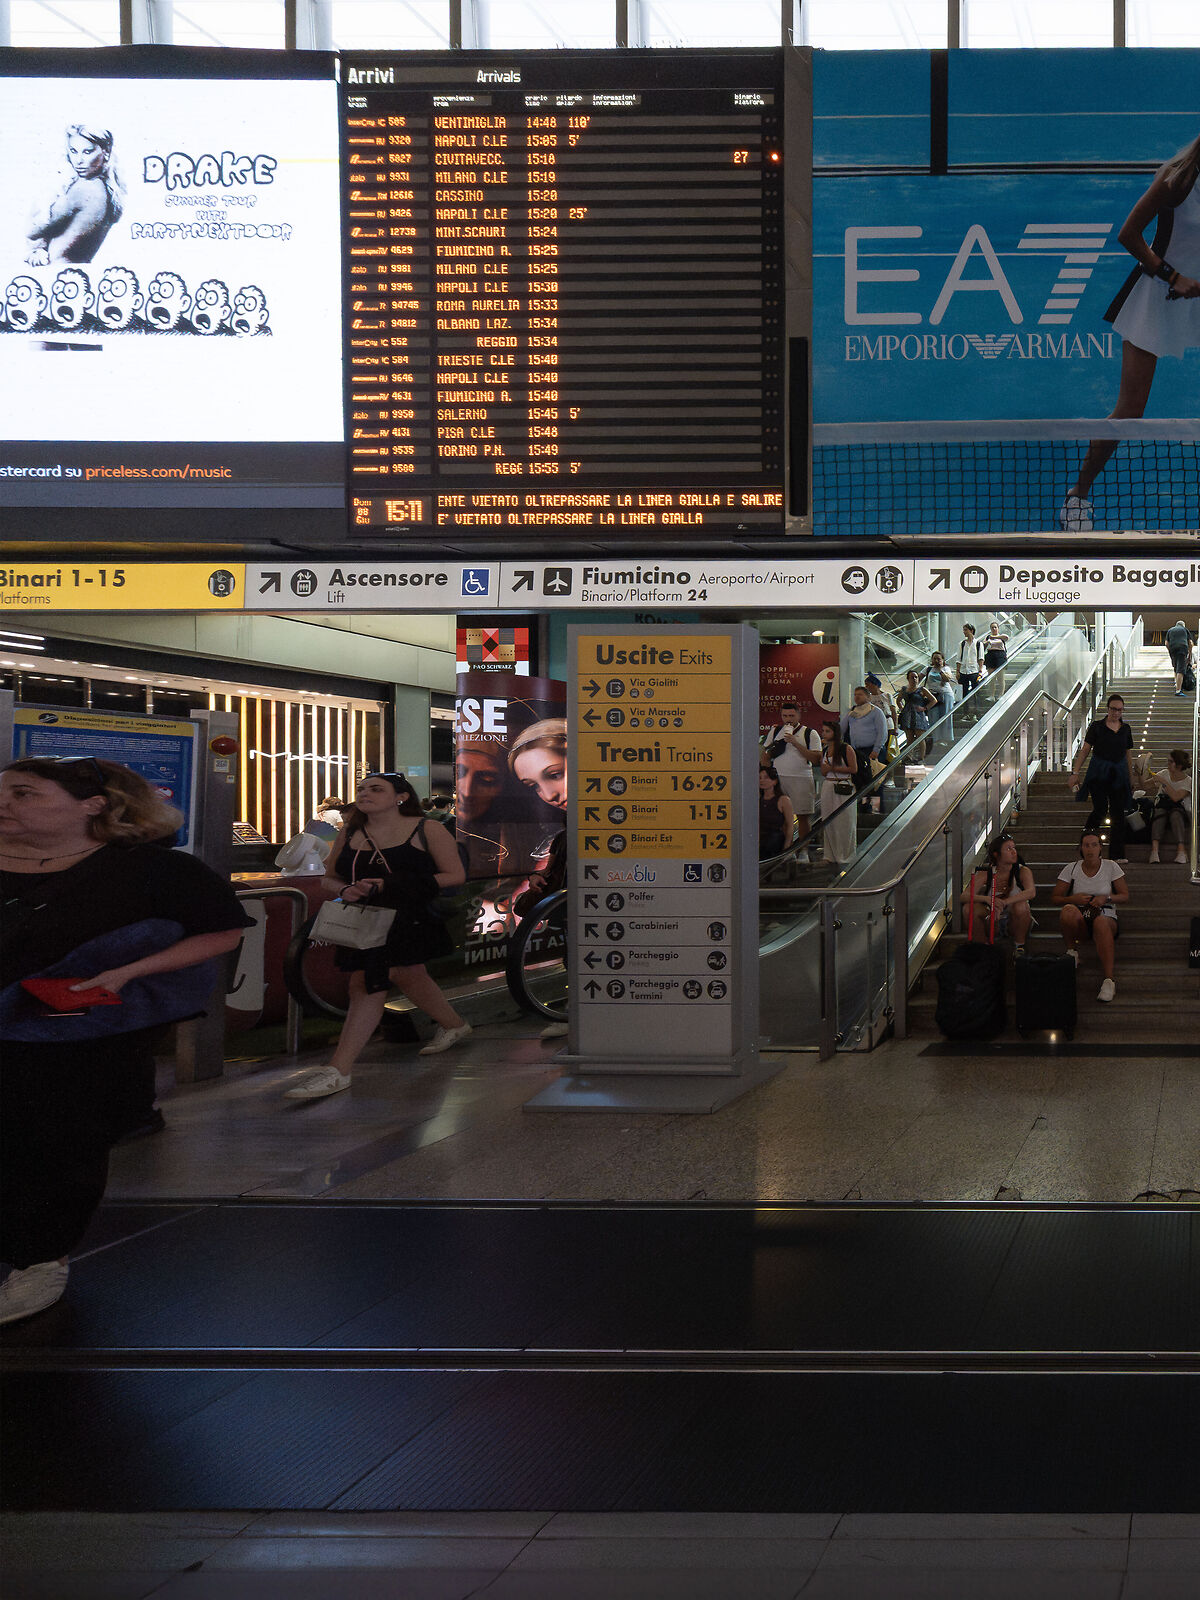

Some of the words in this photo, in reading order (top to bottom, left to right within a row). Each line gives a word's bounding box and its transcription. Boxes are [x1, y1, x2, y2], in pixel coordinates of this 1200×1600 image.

[348, 68, 394, 84] Arrivi
[477, 70, 521, 83] Arrivals
[435, 117, 506, 128] VENTIMIGLIA
[527, 117, 557, 128] 14:48
[435, 153, 505, 165] CIVITAVECC.
[734, 151, 748, 163] 27
[144, 151, 277, 190] DRAKE
[165, 195, 218, 207] SUMMER
[222, 195, 257, 208] TOUR
[131, 222, 292, 240] PARTYNEXTDOOR
[436, 227, 505, 237] MINT.SCAURI
[528, 226, 557, 237] 15:24
[844, 224, 1112, 325] EA7
[437, 300, 465, 311] ROMA
[472, 300, 520, 310] AURELIA
[528, 299, 558, 310] 15:33
[477, 337, 517, 347] REGGIO
[844, 334, 966, 361] EMPORIO
[1008, 333, 1113, 359] ARMANI
[437, 409, 487, 420] SALERNO
[528, 408, 558, 419] 15:45
[65, 469, 81, 477] su
[86, 464, 232, 480] priceless.com/music
[438, 495, 465, 506] ENTE
[472, 495, 518, 506] VIETATO
[525, 495, 610, 506] OLTREPASSARE
[617, 495, 632, 506] LA
[639, 495, 672, 506] LINEA
[679, 494, 720, 506] GIALLA
[727, 494, 734, 505] E
[742, 494, 782, 505] SALIRE
[385, 500, 422, 521] 15:11
[0, 569, 61, 587] Binari
[72, 569, 125, 587] 1-15
[328, 569, 448, 588] Ascensore
[582, 567, 691, 585] Fiumicino
[699, 571, 814, 586] Aeroporto/Airport
[999, 565, 1102, 589] Deposito
[0, 592, 51, 604] latforms
[328, 591, 345, 603] Lift
[582, 589, 683, 603] Binario/Platform
[688, 589, 707, 601] 24
[999, 587, 1021, 601] Left
[1024, 588, 1081, 605] Luggage
[597, 644, 674, 664] Uscite
[680, 650, 712, 664] Exits
[630, 708, 645, 716] Via
[649, 708, 685, 716] Marsala
[597, 742, 660, 762] Treni
[667, 747, 712, 762] Trains
[631, 776, 657, 784] Binari
[629, 893, 654, 901] Polfer
[629, 922, 678, 930] Carabinieri
[629, 952, 679, 961] Parcheggio
[629, 980, 679, 989] Parcheggio
